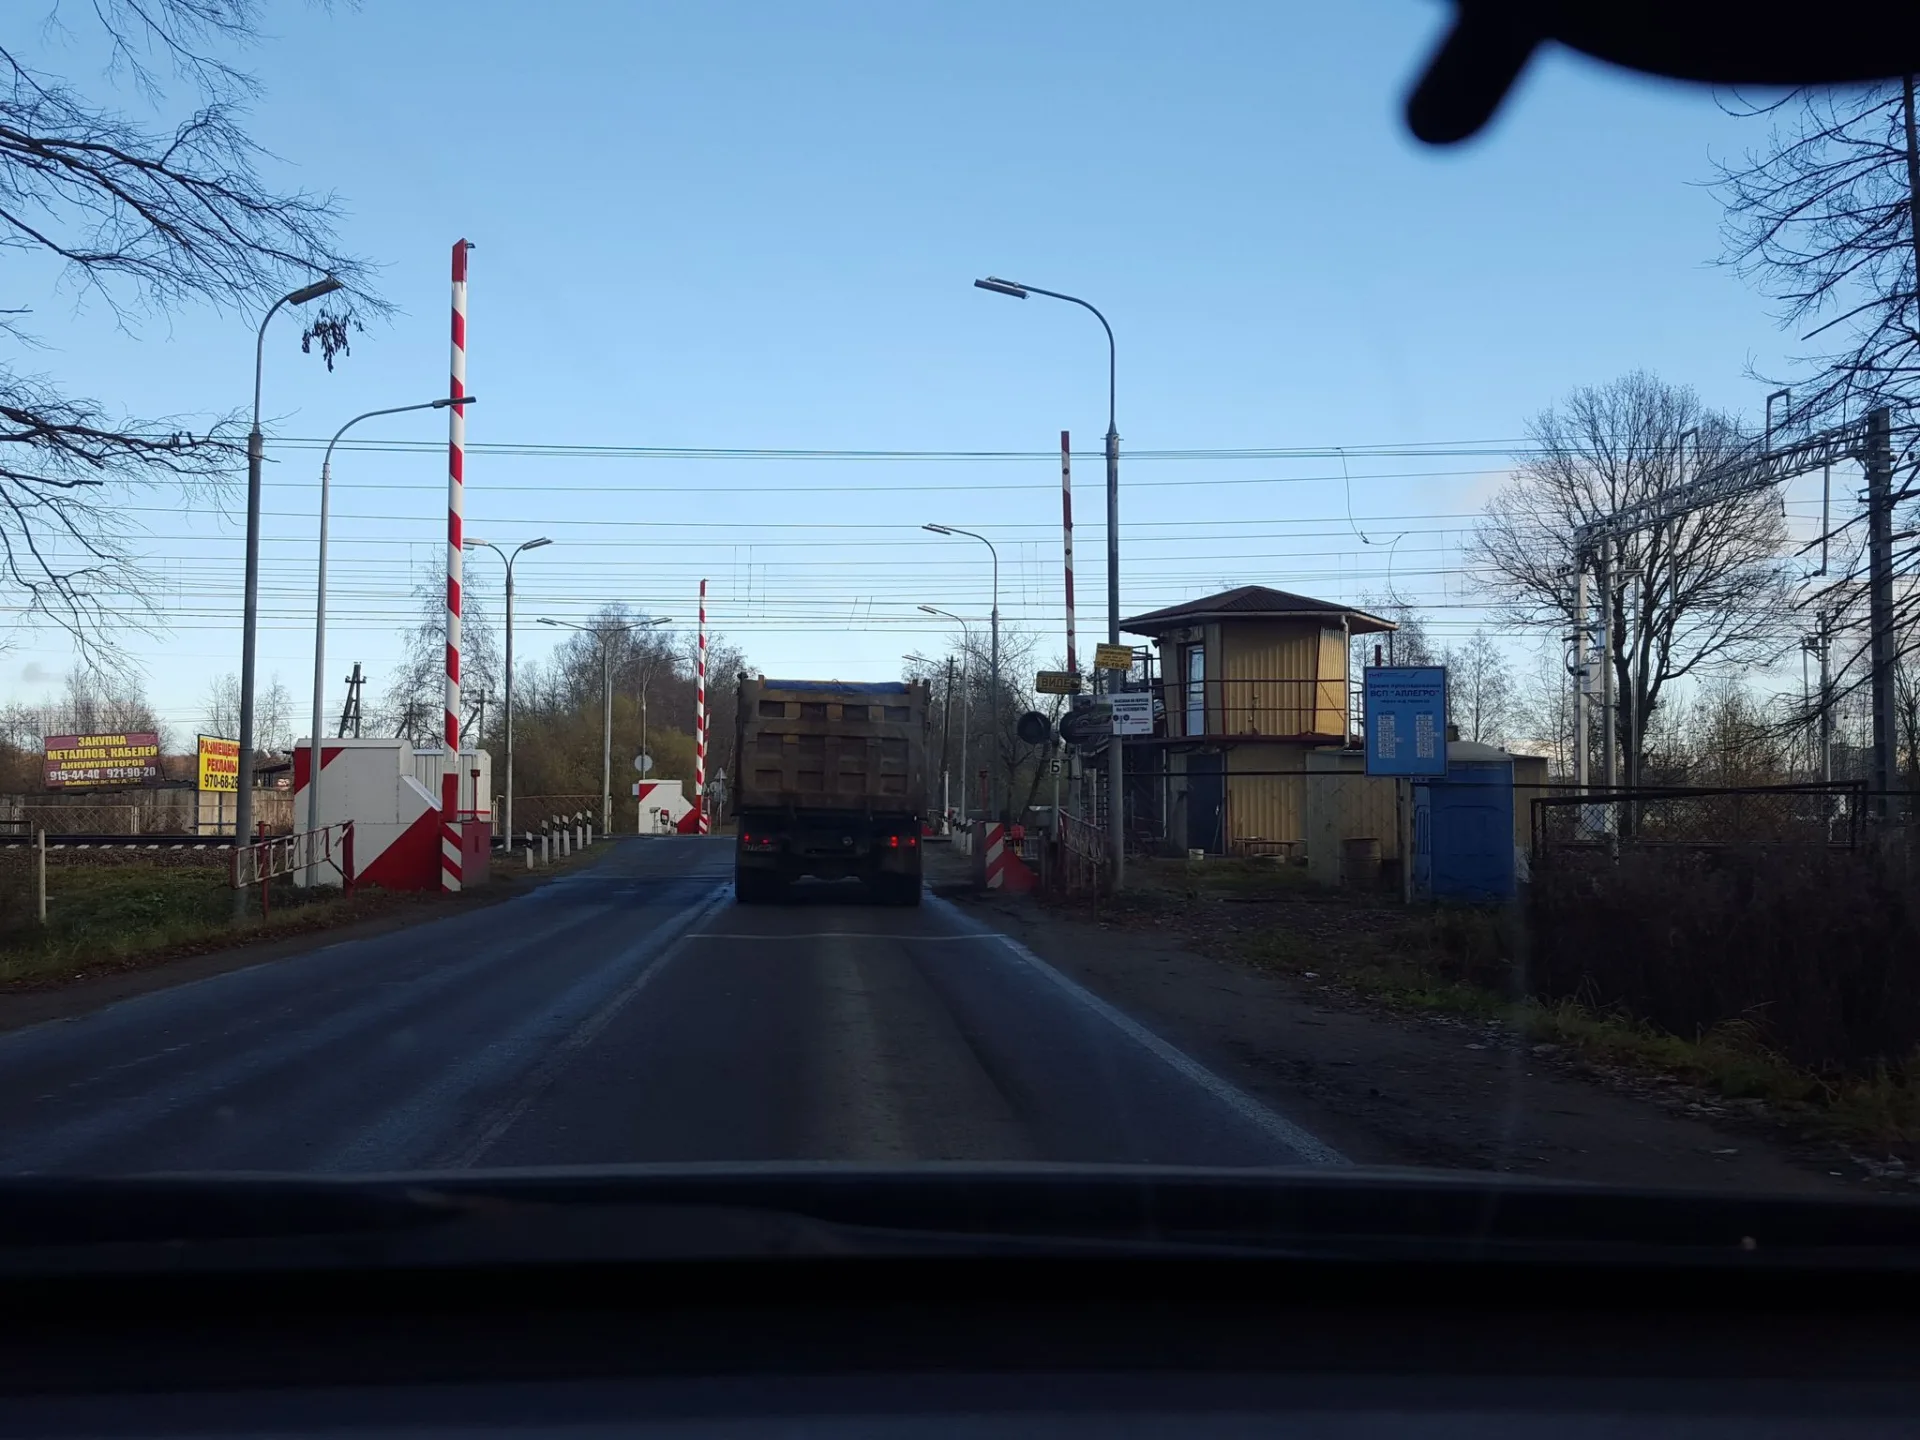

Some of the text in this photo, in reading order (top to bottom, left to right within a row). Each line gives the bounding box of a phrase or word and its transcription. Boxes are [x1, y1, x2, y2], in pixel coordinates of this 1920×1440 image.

[1041, 677, 1078, 689] ВИДЕ
[78, 735, 127, 747] ЗАКУПКА
[111, 745, 158, 757] КАБЕЛЕЙ
[61, 759, 145, 770] АККУМУЛЯТОРОВ
[207, 758, 237, 773] РЕКЛАМЫ
[50, 767, 156, 781] 915-44-40 921-90-20
